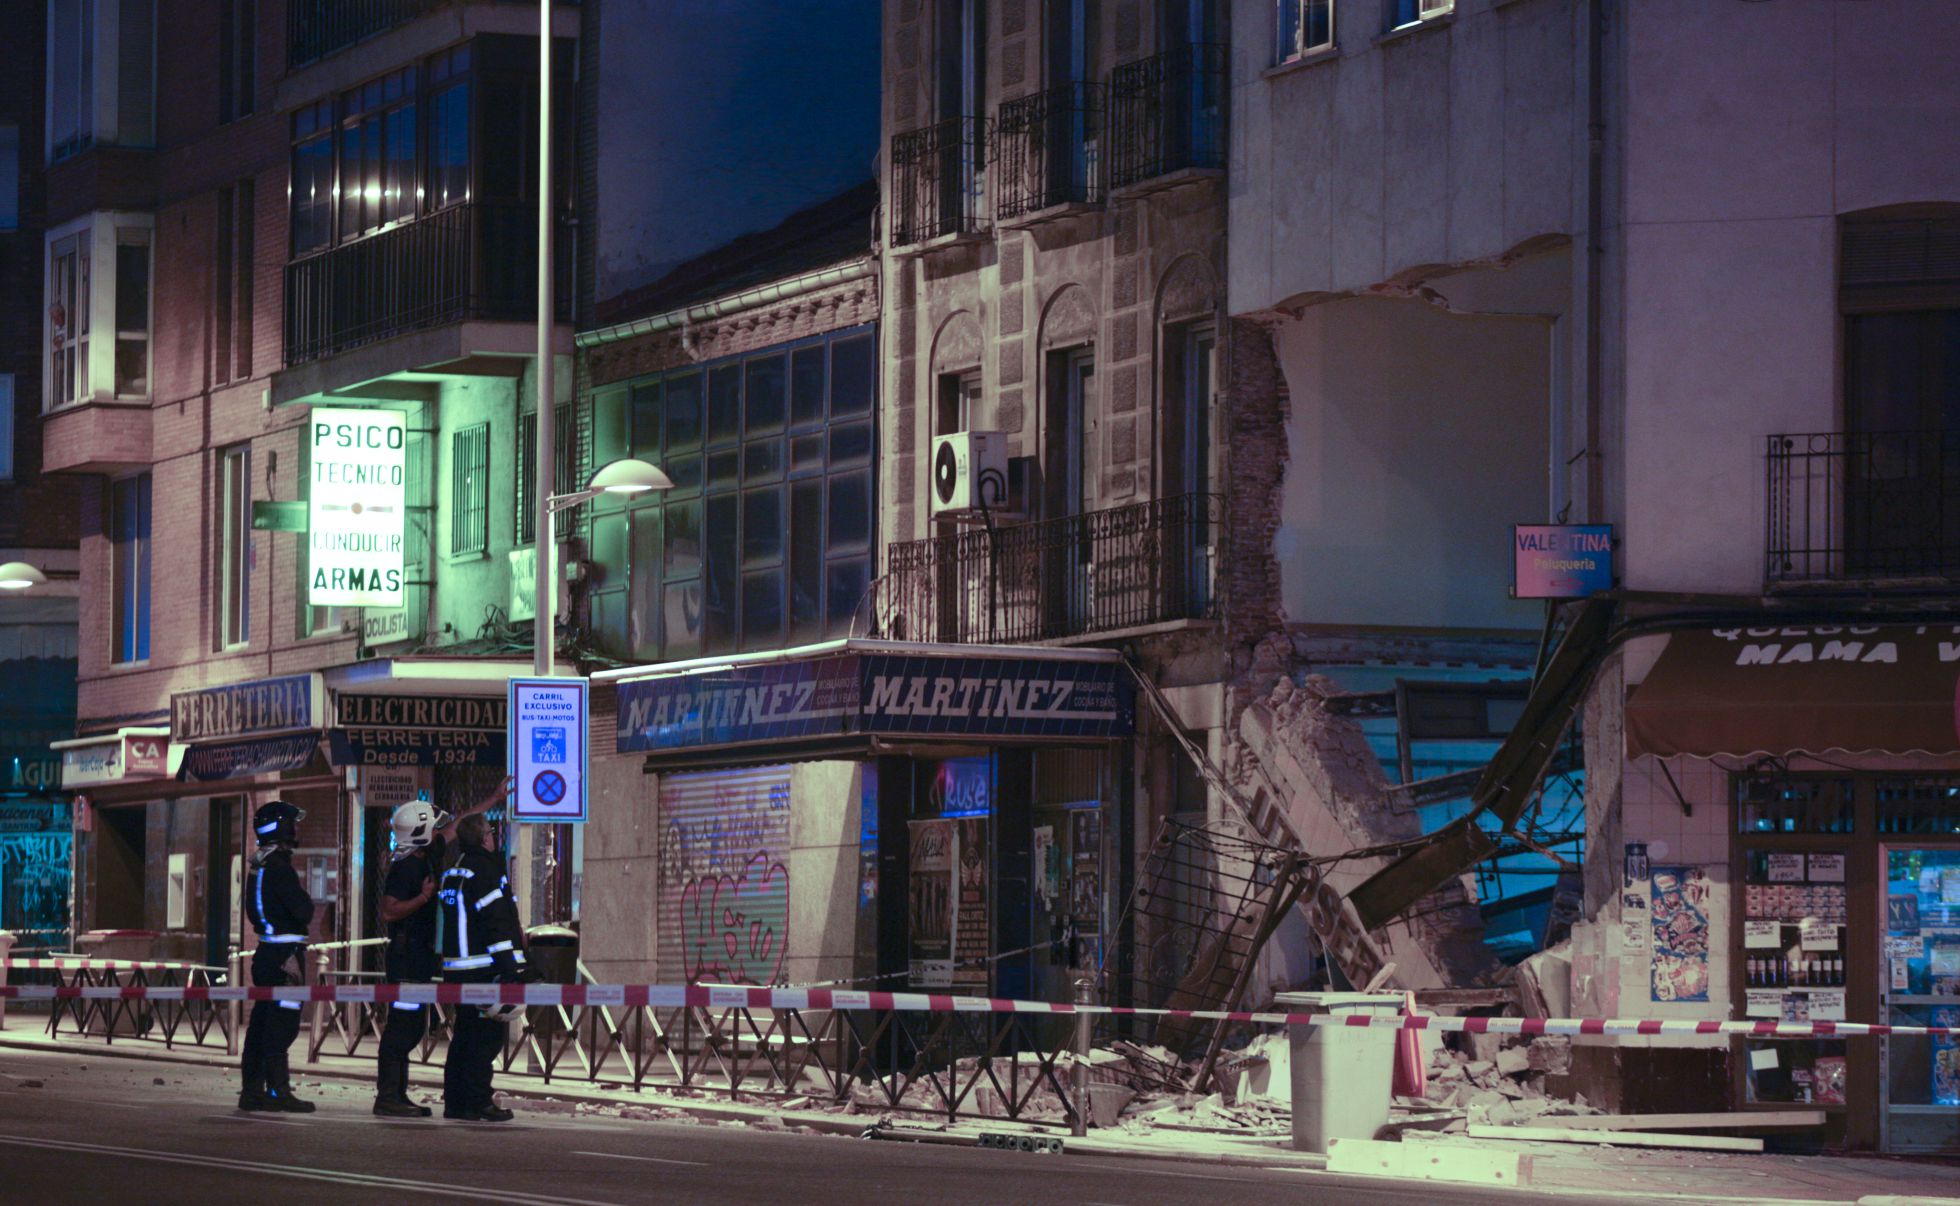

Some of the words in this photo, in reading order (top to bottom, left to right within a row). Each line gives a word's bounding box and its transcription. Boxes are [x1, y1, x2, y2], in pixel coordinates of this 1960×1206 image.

[315, 423, 403, 450] PSICO
[314, 461, 402, 486] TECNICO
[312, 530, 401, 553] CONDUCIR
[1518, 533, 1610, 552] VALETINA
[313, 567, 401, 593] ARMAS
[365, 611, 408, 638] OCULISTA
[1735, 640, 1898, 665] MAMA
[524, 703, 573, 711] EXCLUSIVO
[533, 693, 564, 701] CARRIL
[175, 680, 308, 740] FERRETERIA
[347, 730, 489, 746] FERRETERIA
[364, 749, 419, 763] Desde
[537, 753, 561, 763] TAXI
